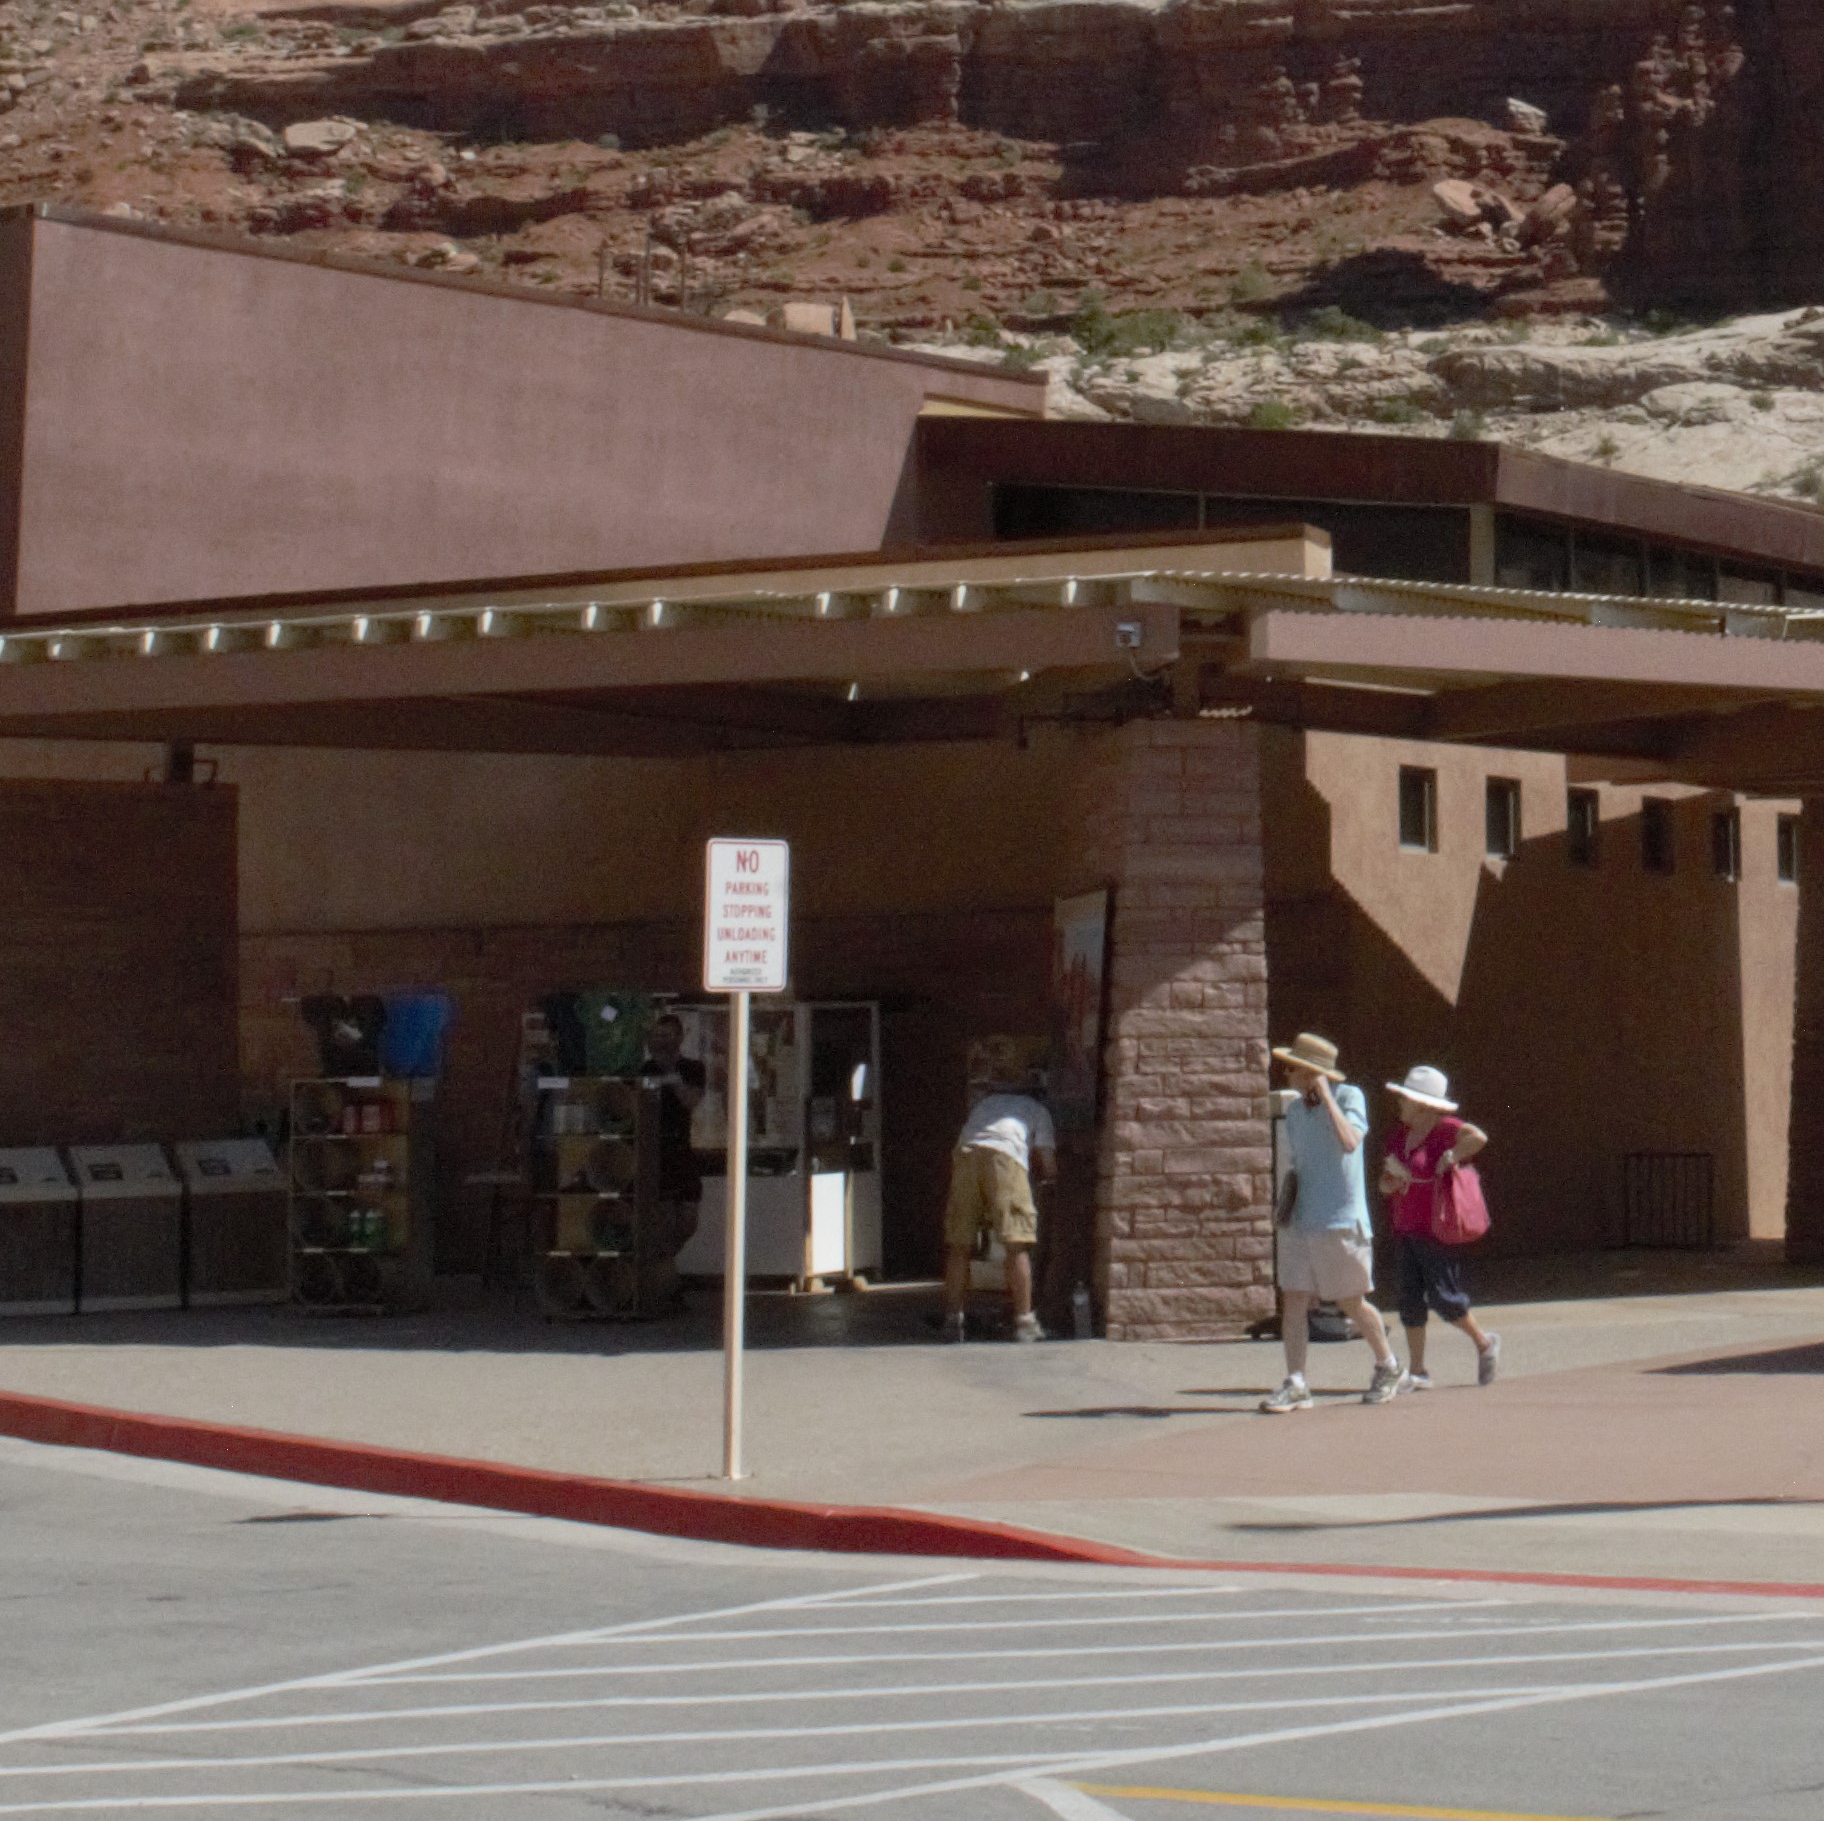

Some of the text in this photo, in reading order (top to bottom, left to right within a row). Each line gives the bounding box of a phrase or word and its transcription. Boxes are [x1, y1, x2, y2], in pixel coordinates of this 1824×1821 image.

[736, 849, 760, 873] NO
[725, 882, 769, 897] PARKING
[723, 904, 772, 919] STOPPING
[717, 927, 776, 941] UNLOADING
[725, 950, 768, 964] ANYTIME
